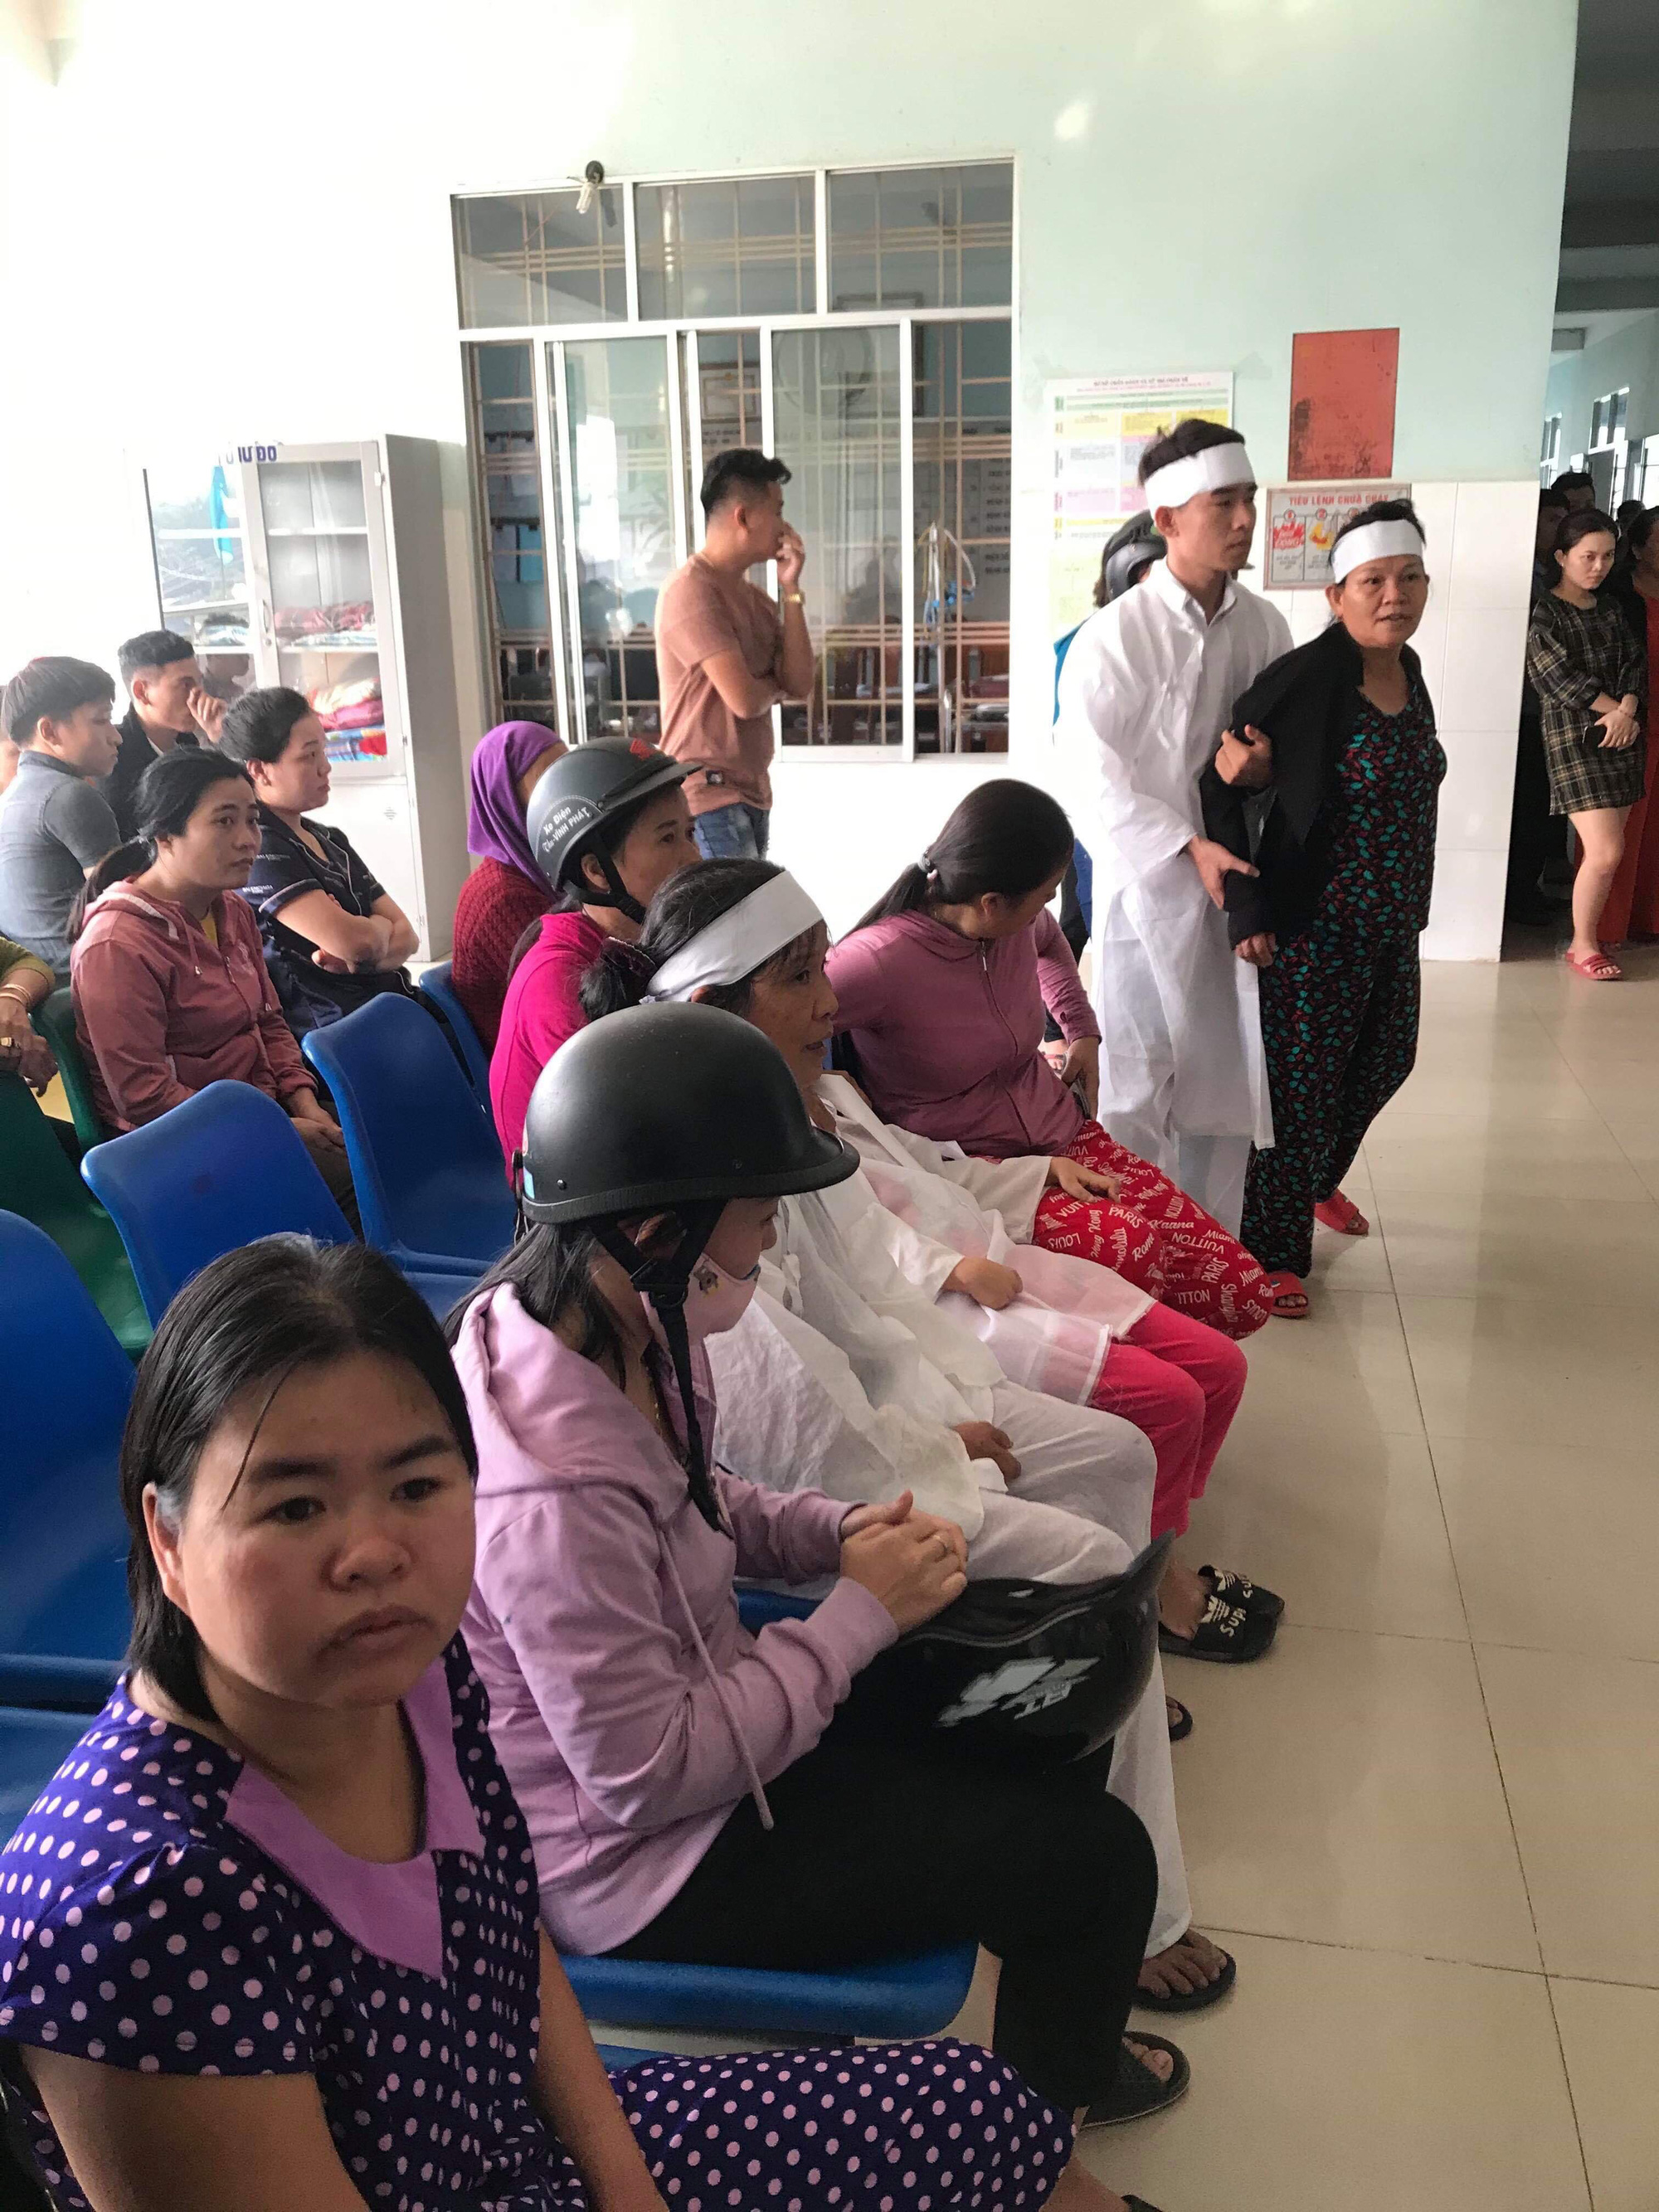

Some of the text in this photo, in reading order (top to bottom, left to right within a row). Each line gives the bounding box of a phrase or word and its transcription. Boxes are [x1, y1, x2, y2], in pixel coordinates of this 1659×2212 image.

[543, 823, 553, 835] Xe
[1108, 1206, 1145, 1228] PARIS
[1048, 1232, 1082, 1250] LOUIS
[1171, 1232, 1225, 1256] VUITTON
[1201, 1257, 1229, 1285] PARIS
[1174, 1288, 1211, 1305] ITTON
